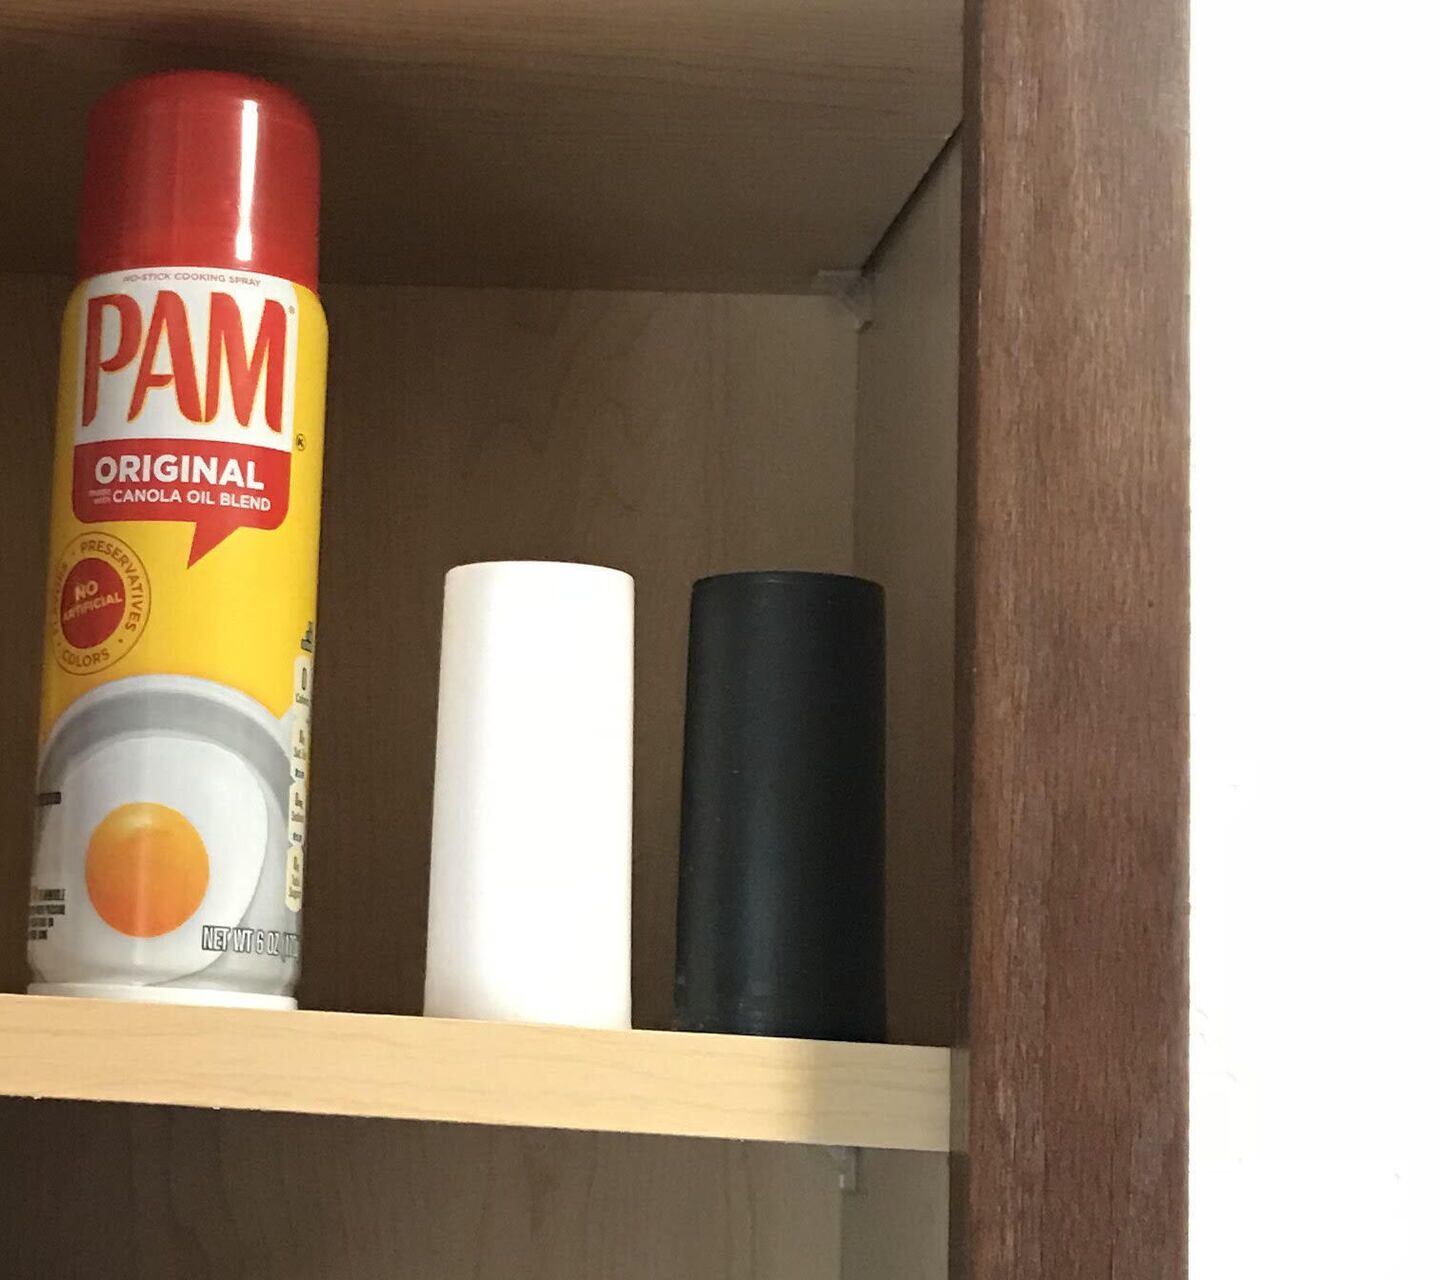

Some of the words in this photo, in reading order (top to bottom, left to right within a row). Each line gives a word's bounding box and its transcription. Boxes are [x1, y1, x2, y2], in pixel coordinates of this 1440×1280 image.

[174, 272, 226, 283] COOKING
[228, 275, 262, 287] SPRAY
[82, 289, 288, 434] PAM
[94, 454, 265, 491] ORIGINAL
[113, 488, 183, 504] CANOLA
[187, 489, 216, 505] OIL
[219, 492, 272, 511] BLEND
[75, 580, 99, 601] NO
[80, 540, 145, 632] PRESERVATIVES
[63, 591, 123, 622] ARTIFICIAL
[62, 647, 111, 668] COLORS
[202, 924, 231, 952] NET
[232, 926, 255, 954] WT
[255, 928, 266, 955] 6
